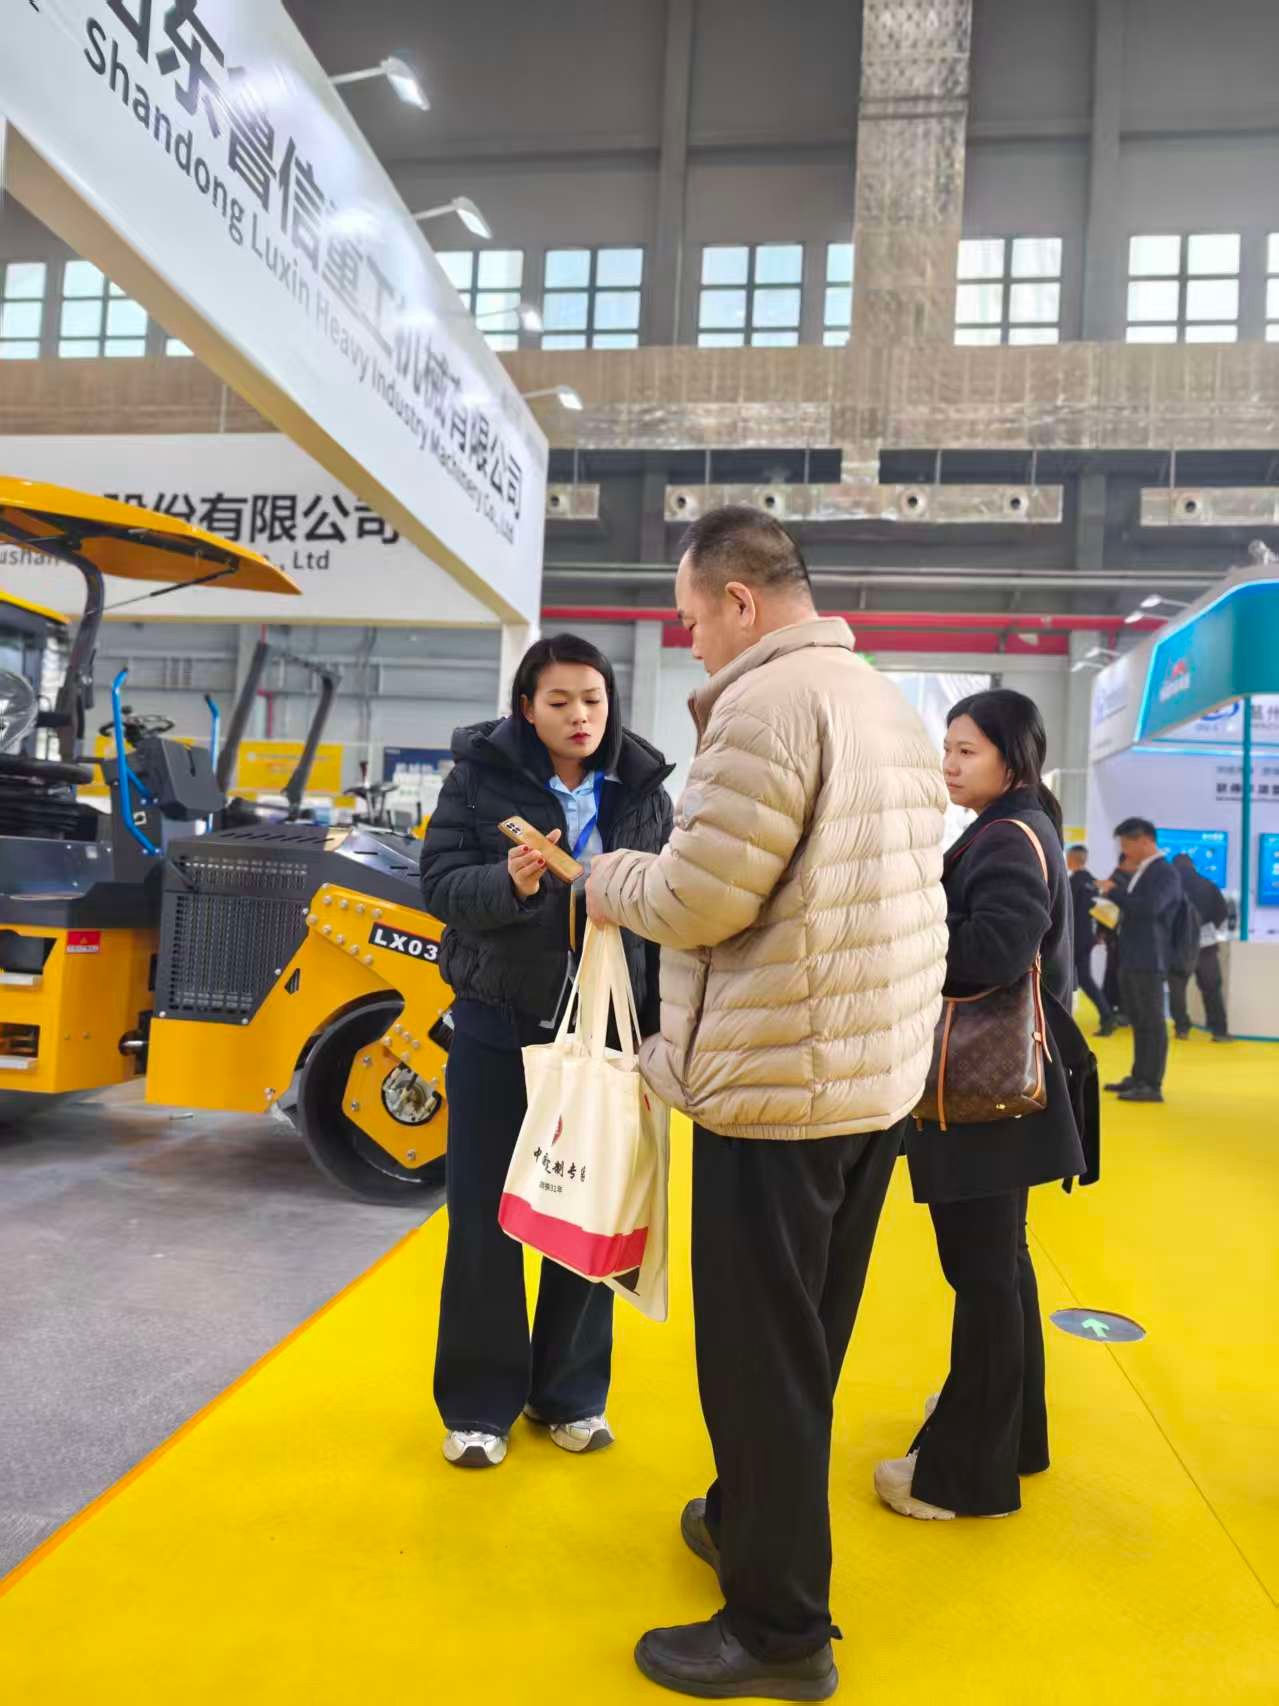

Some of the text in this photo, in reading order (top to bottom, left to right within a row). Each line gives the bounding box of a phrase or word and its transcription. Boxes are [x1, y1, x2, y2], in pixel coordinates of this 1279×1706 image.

[83, 17, 245, 246] Shandong
[251, 212, 310, 316] Luxin
[316, 287, 369, 382] Heavy
[371, 354, 429, 451] Industry
[293, 549, 330, 570] Ltd
[374, 927, 439, 962] LX03
